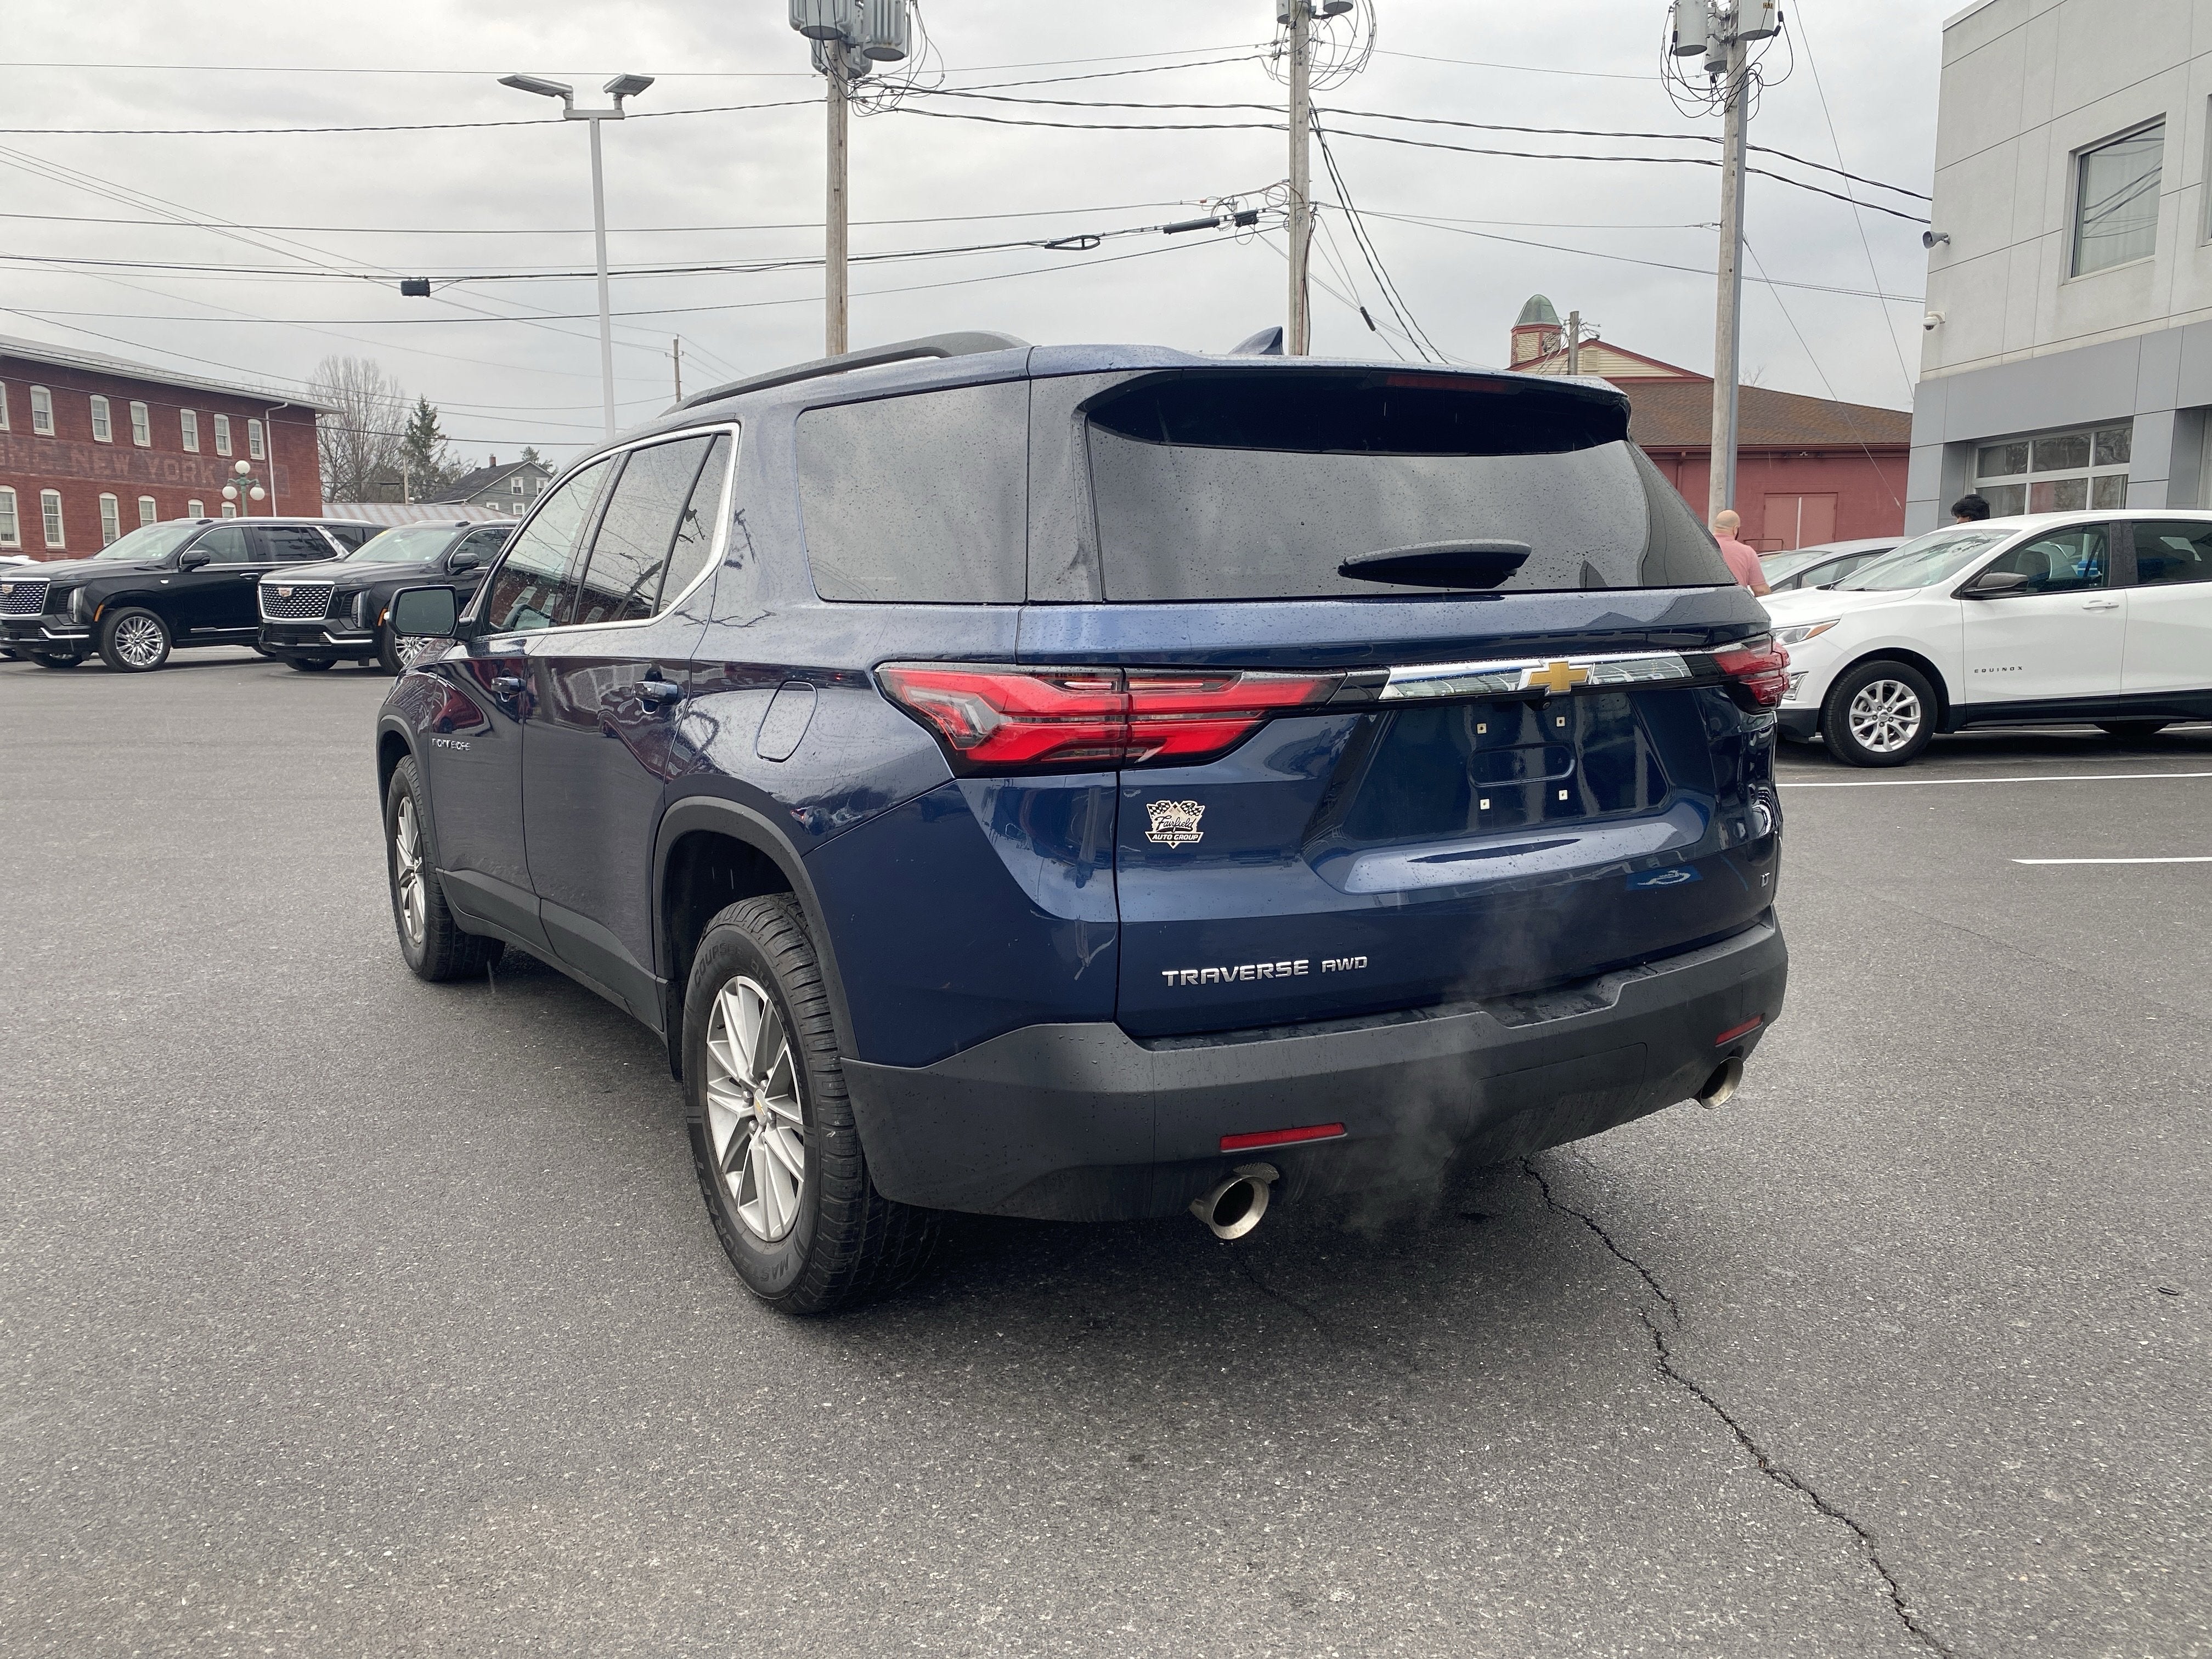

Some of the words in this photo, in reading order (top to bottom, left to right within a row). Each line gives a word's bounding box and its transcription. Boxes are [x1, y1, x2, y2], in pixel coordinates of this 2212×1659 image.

[70, 447, 130, 476] NEW
[145, 456, 215, 484] YORK
[1154, 815, 1197, 832] Fairfield
[1161, 960, 1309, 987] TRAVERSE
[1322, 956, 1368, 973] AWD
